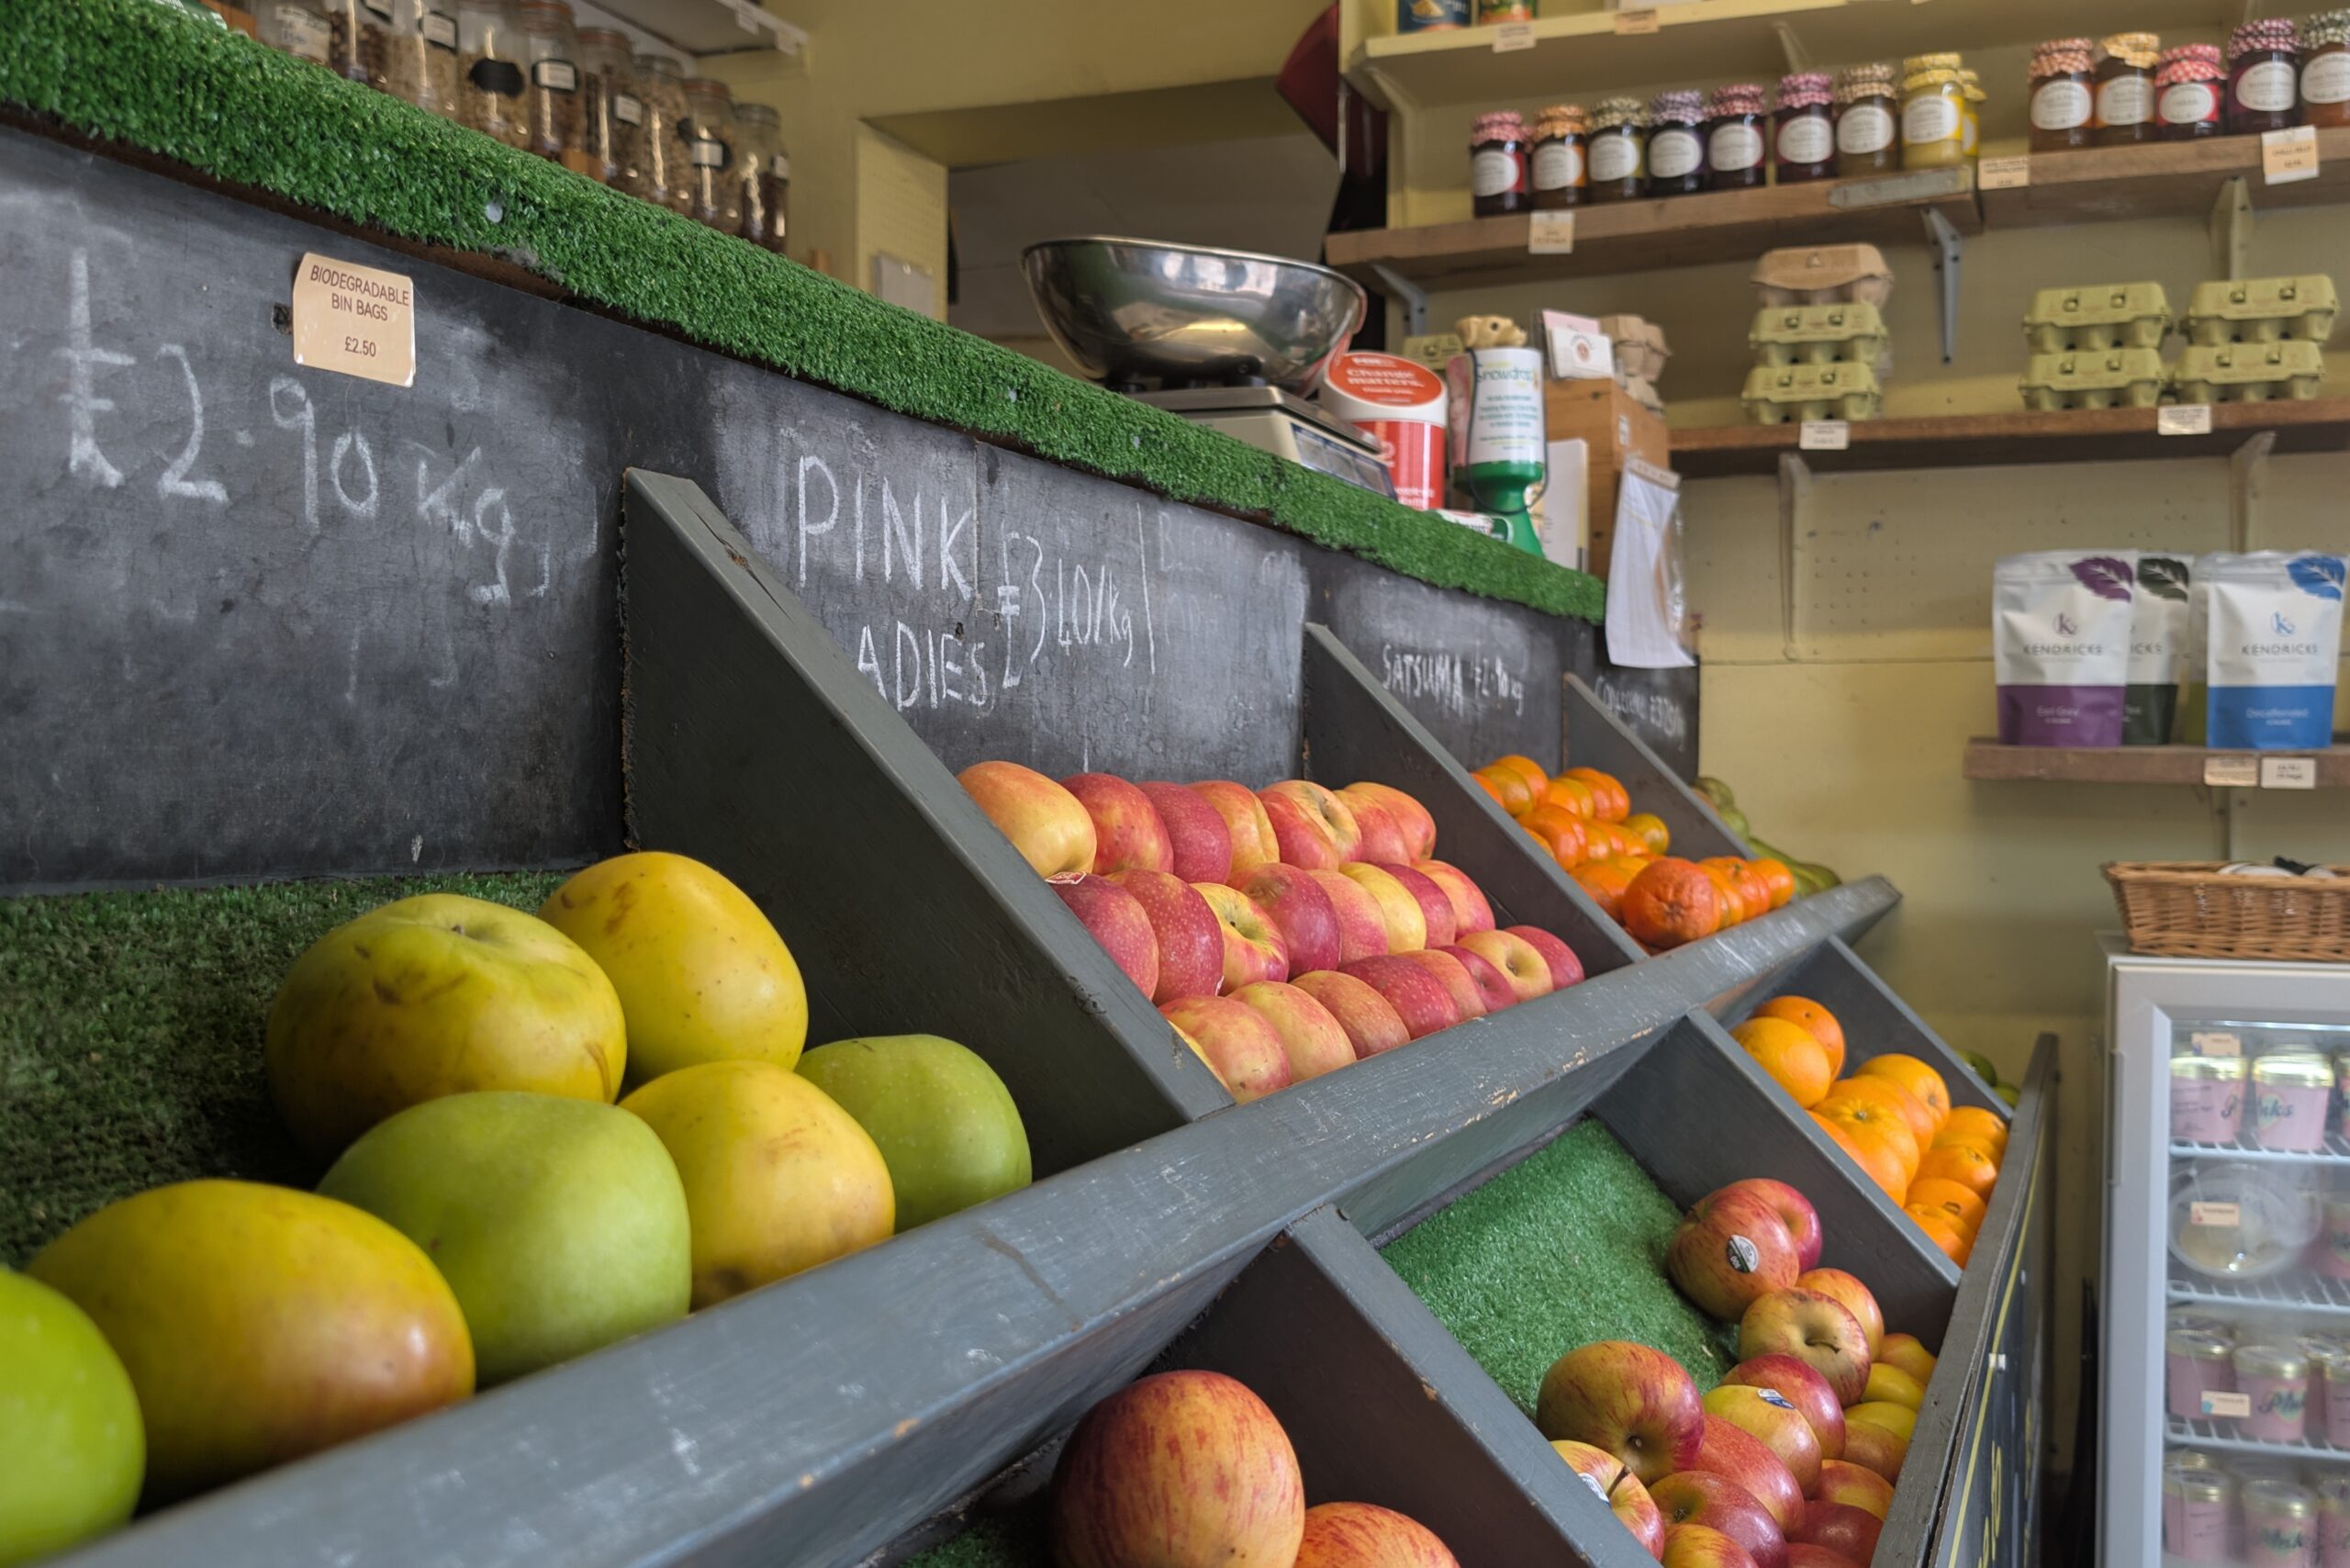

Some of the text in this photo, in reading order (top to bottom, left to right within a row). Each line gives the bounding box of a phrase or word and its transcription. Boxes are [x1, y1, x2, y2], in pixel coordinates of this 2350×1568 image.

[310, 264, 410, 307] BIODEGRADABLE
[331, 293, 388, 321] BIN BAGS
[344, 336, 377, 358] £2.50
[797, 454, 975, 602] PINK
[2022, 643, 2104, 656] KENDRICKS
[2242, 644, 2319, 655] KENDRICKS
[856, 620, 991, 713] ADIES
